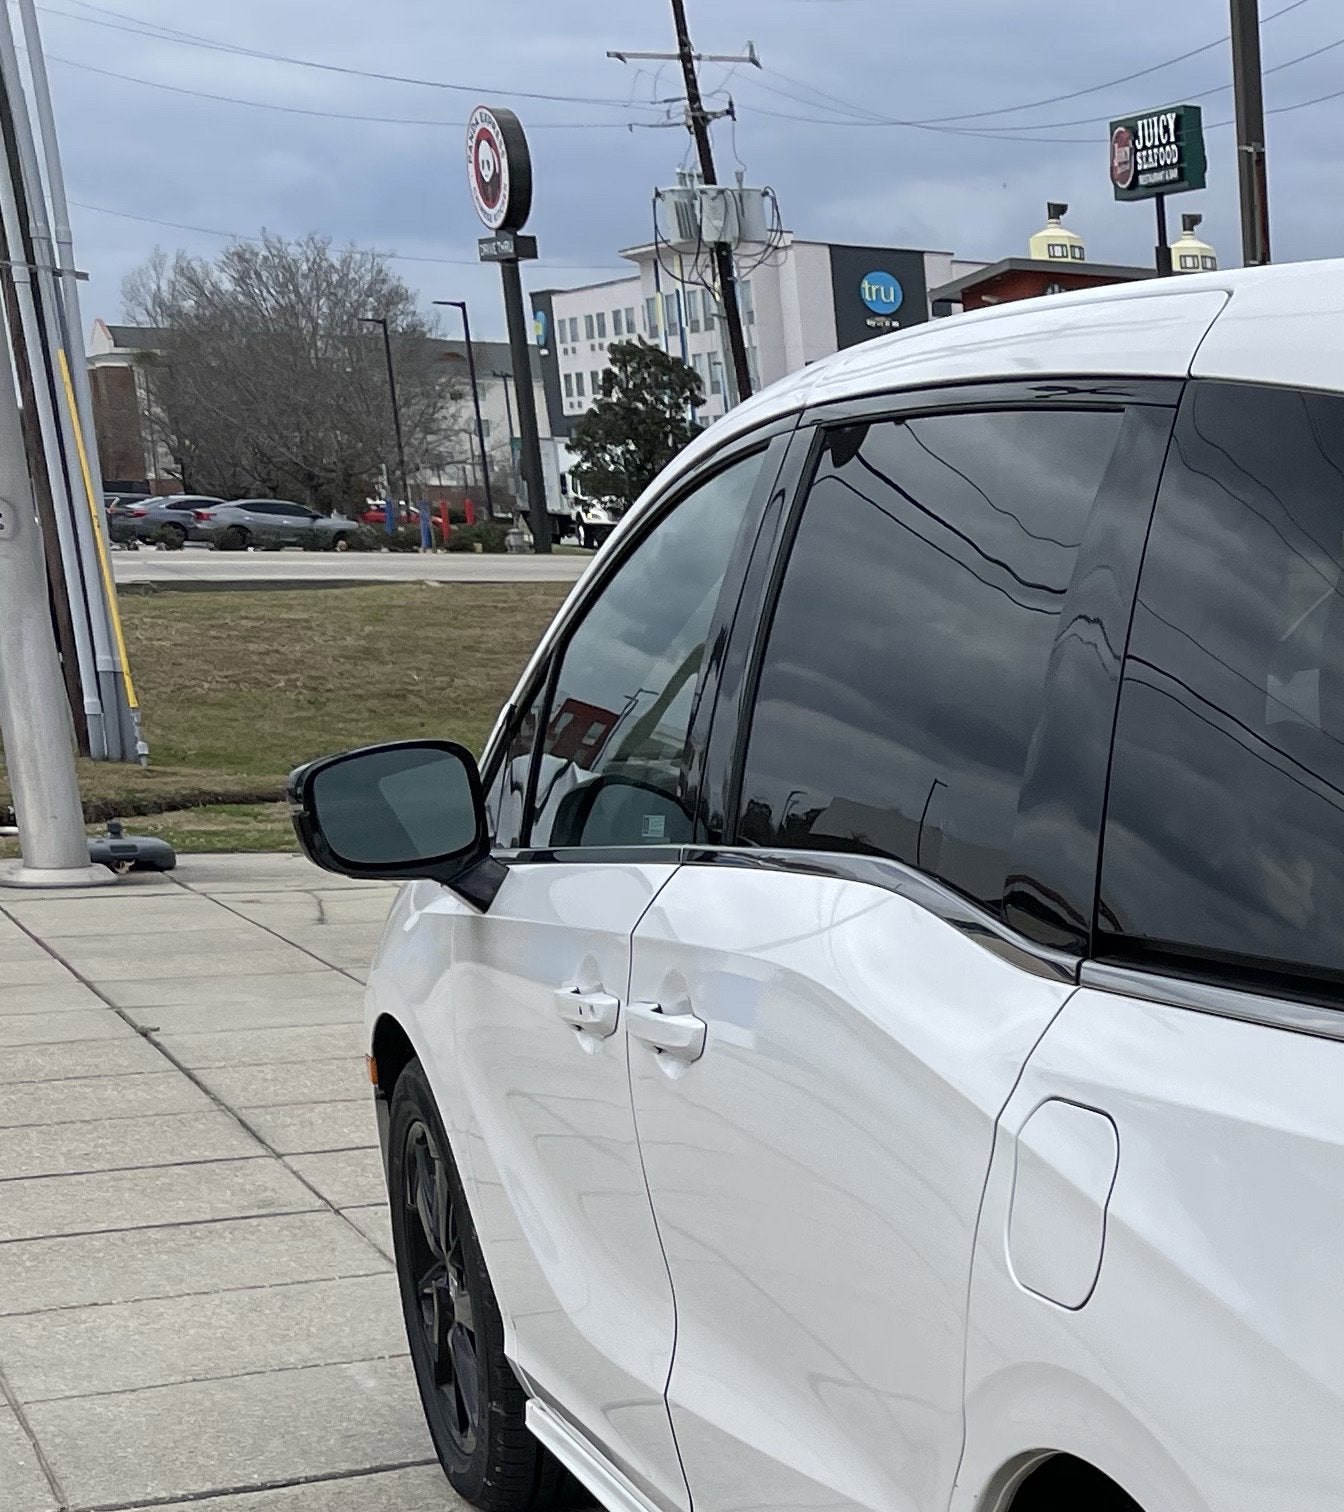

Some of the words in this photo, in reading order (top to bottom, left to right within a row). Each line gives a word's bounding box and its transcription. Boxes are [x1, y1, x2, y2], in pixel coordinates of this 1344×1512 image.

[467, 117, 480, 164] PANDA
[479, 111, 505, 159] EXPRESS
[1135, 112, 1176, 149] JUICY
[1136, 144, 1179, 171] SEAFOOD
[862, 280, 895, 303] tru
